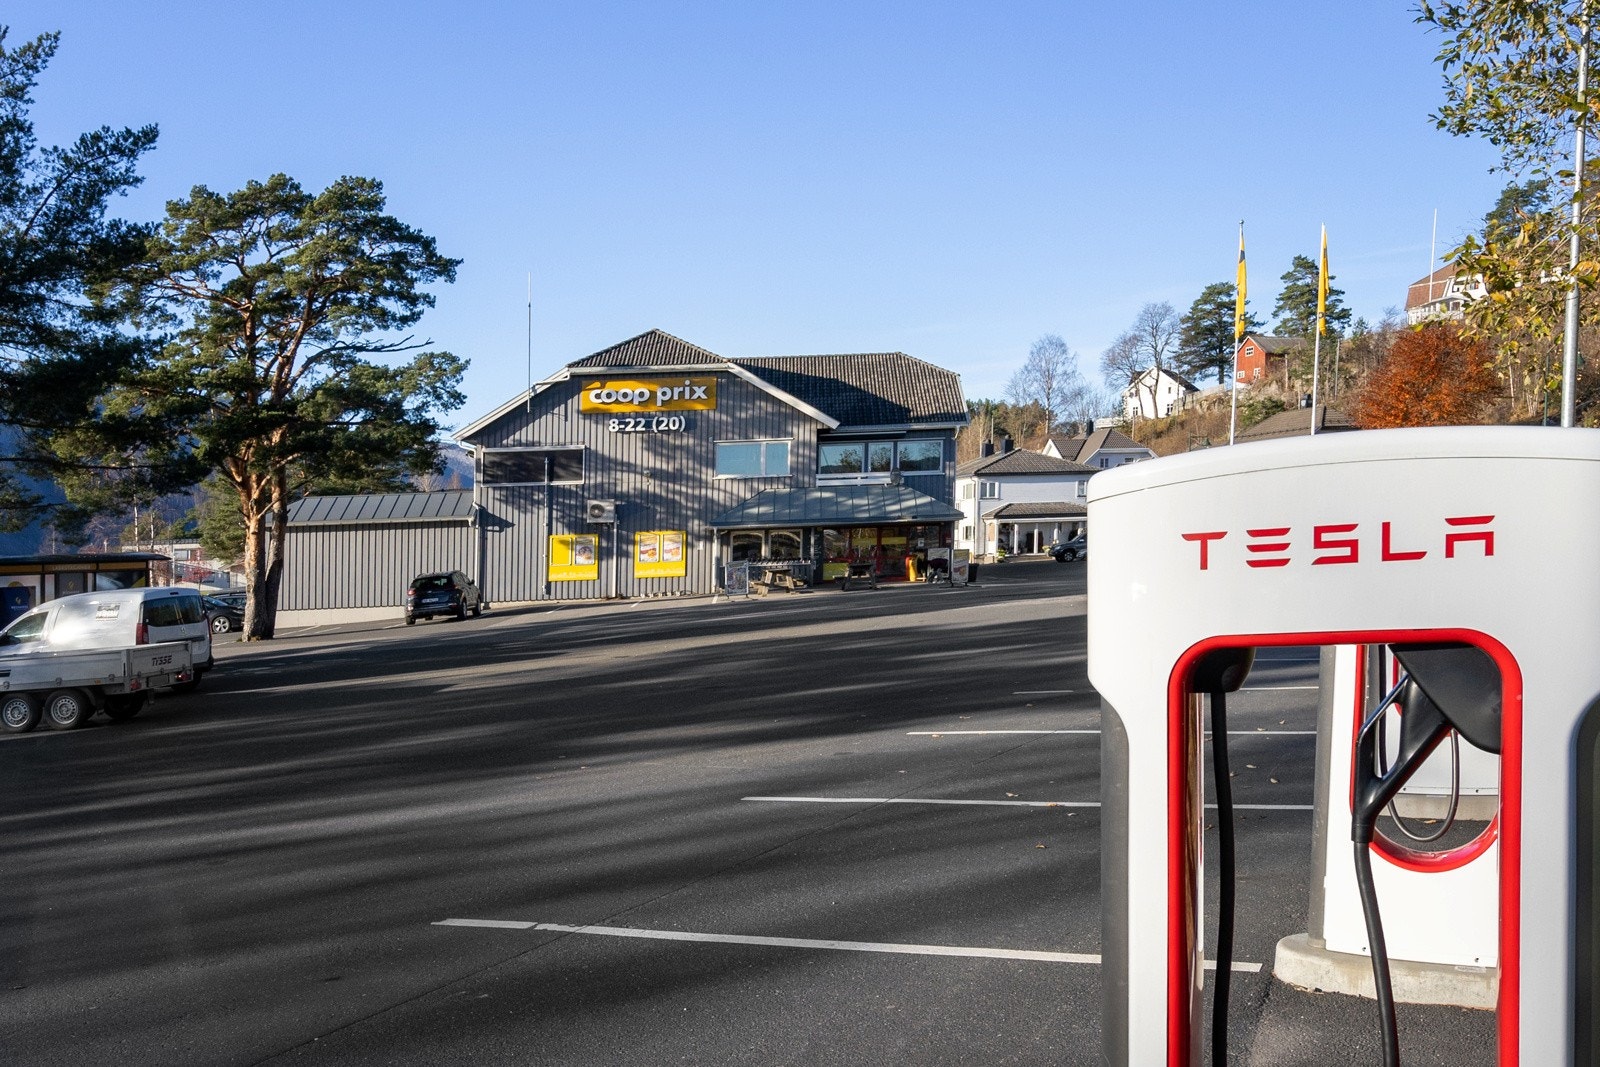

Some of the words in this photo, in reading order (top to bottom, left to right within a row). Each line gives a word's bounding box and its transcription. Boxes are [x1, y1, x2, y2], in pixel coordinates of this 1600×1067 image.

[589, 388, 650, 405] coop
[656, 380, 708, 406] prix
[609, 418, 646, 432] 8-22
[652, 416, 686, 433] (20)
[1182, 515, 1495, 570] TESLA
